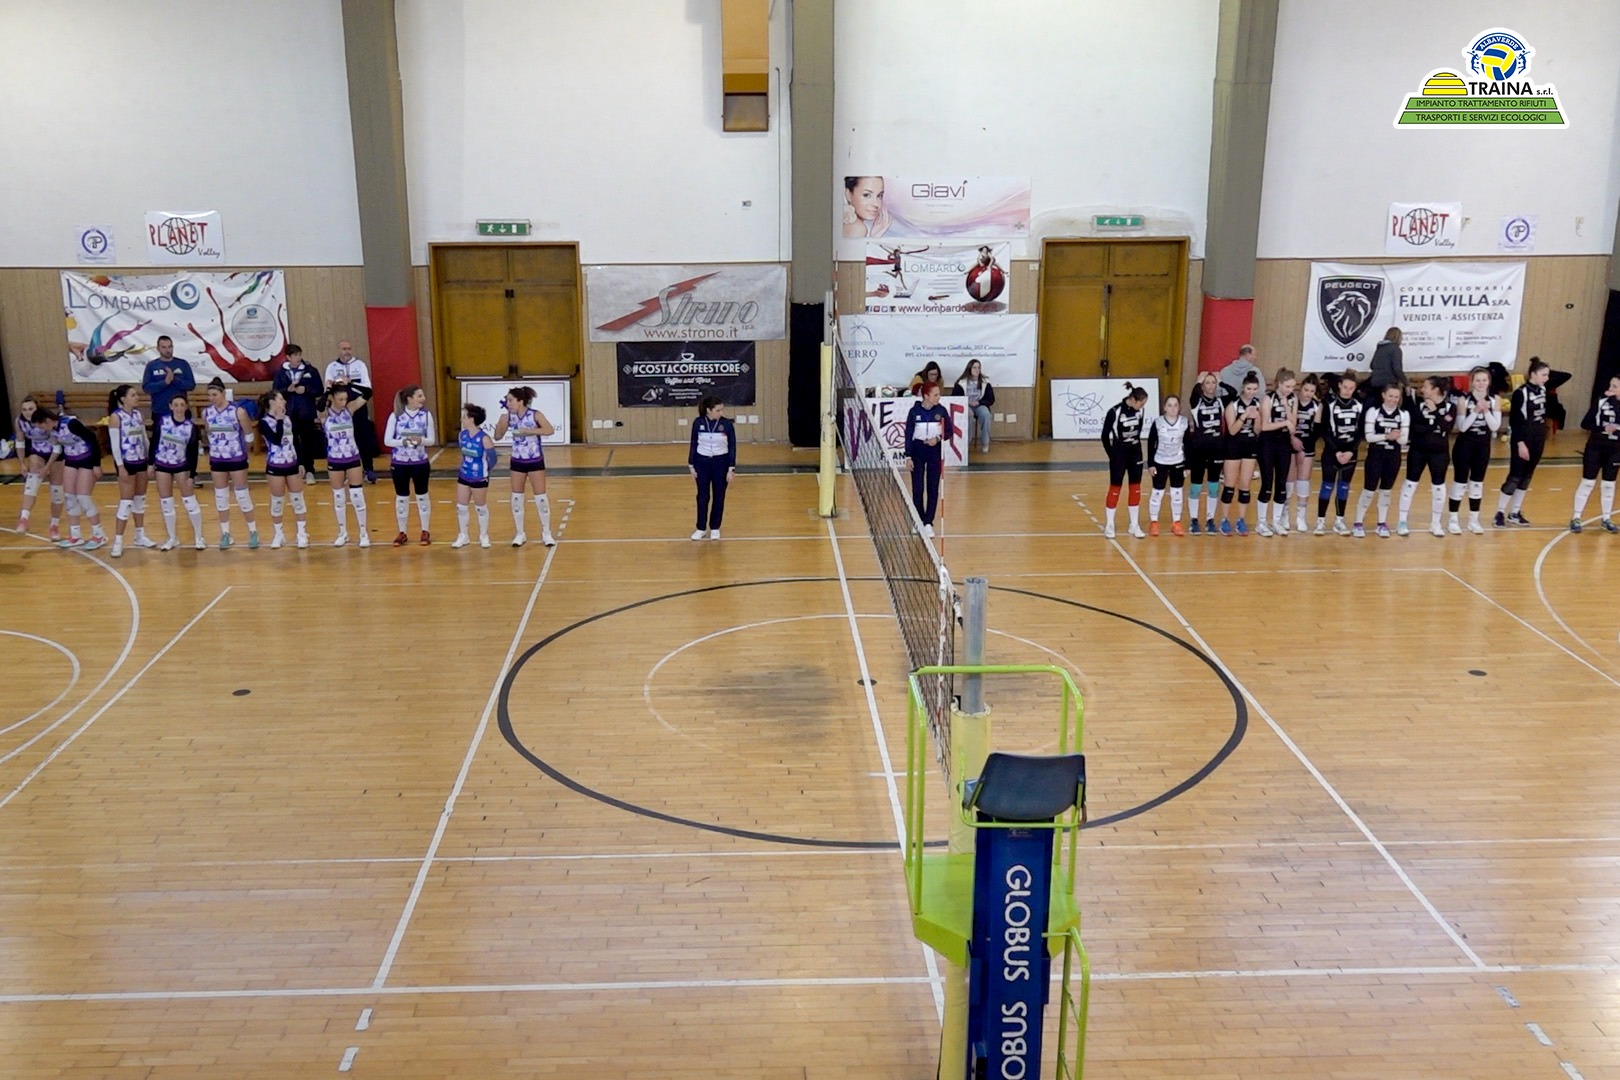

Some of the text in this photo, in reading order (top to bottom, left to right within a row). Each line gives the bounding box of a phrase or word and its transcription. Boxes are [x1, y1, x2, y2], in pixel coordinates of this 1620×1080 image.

[1391, 213, 1450, 238] PLANET
[149, 223, 208, 247] PLANET
[1324, 281, 1378, 290] PEUGEOT
[1400, 285, 1513, 293] CONCESSIONARIA
[1399, 294, 1435, 307] F.LLI
[1440, 294, 1490, 307] VILLA
[1402, 313, 1442, 322] VENDITA
[1451, 312, 1505, 321] ASSISTENZA
[644, 327, 738, 339] www.strano.it
[844, 349, 878, 359] ERRO
[632, 362, 741, 375] #COSTACOFFEESTORE
[1078, 417, 1099, 425] Nico
[337, 430, 347, 440] 12
[1004, 865, 1031, 982] GLOBUS
[1001, 1001, 1028, 1080] OBUS
